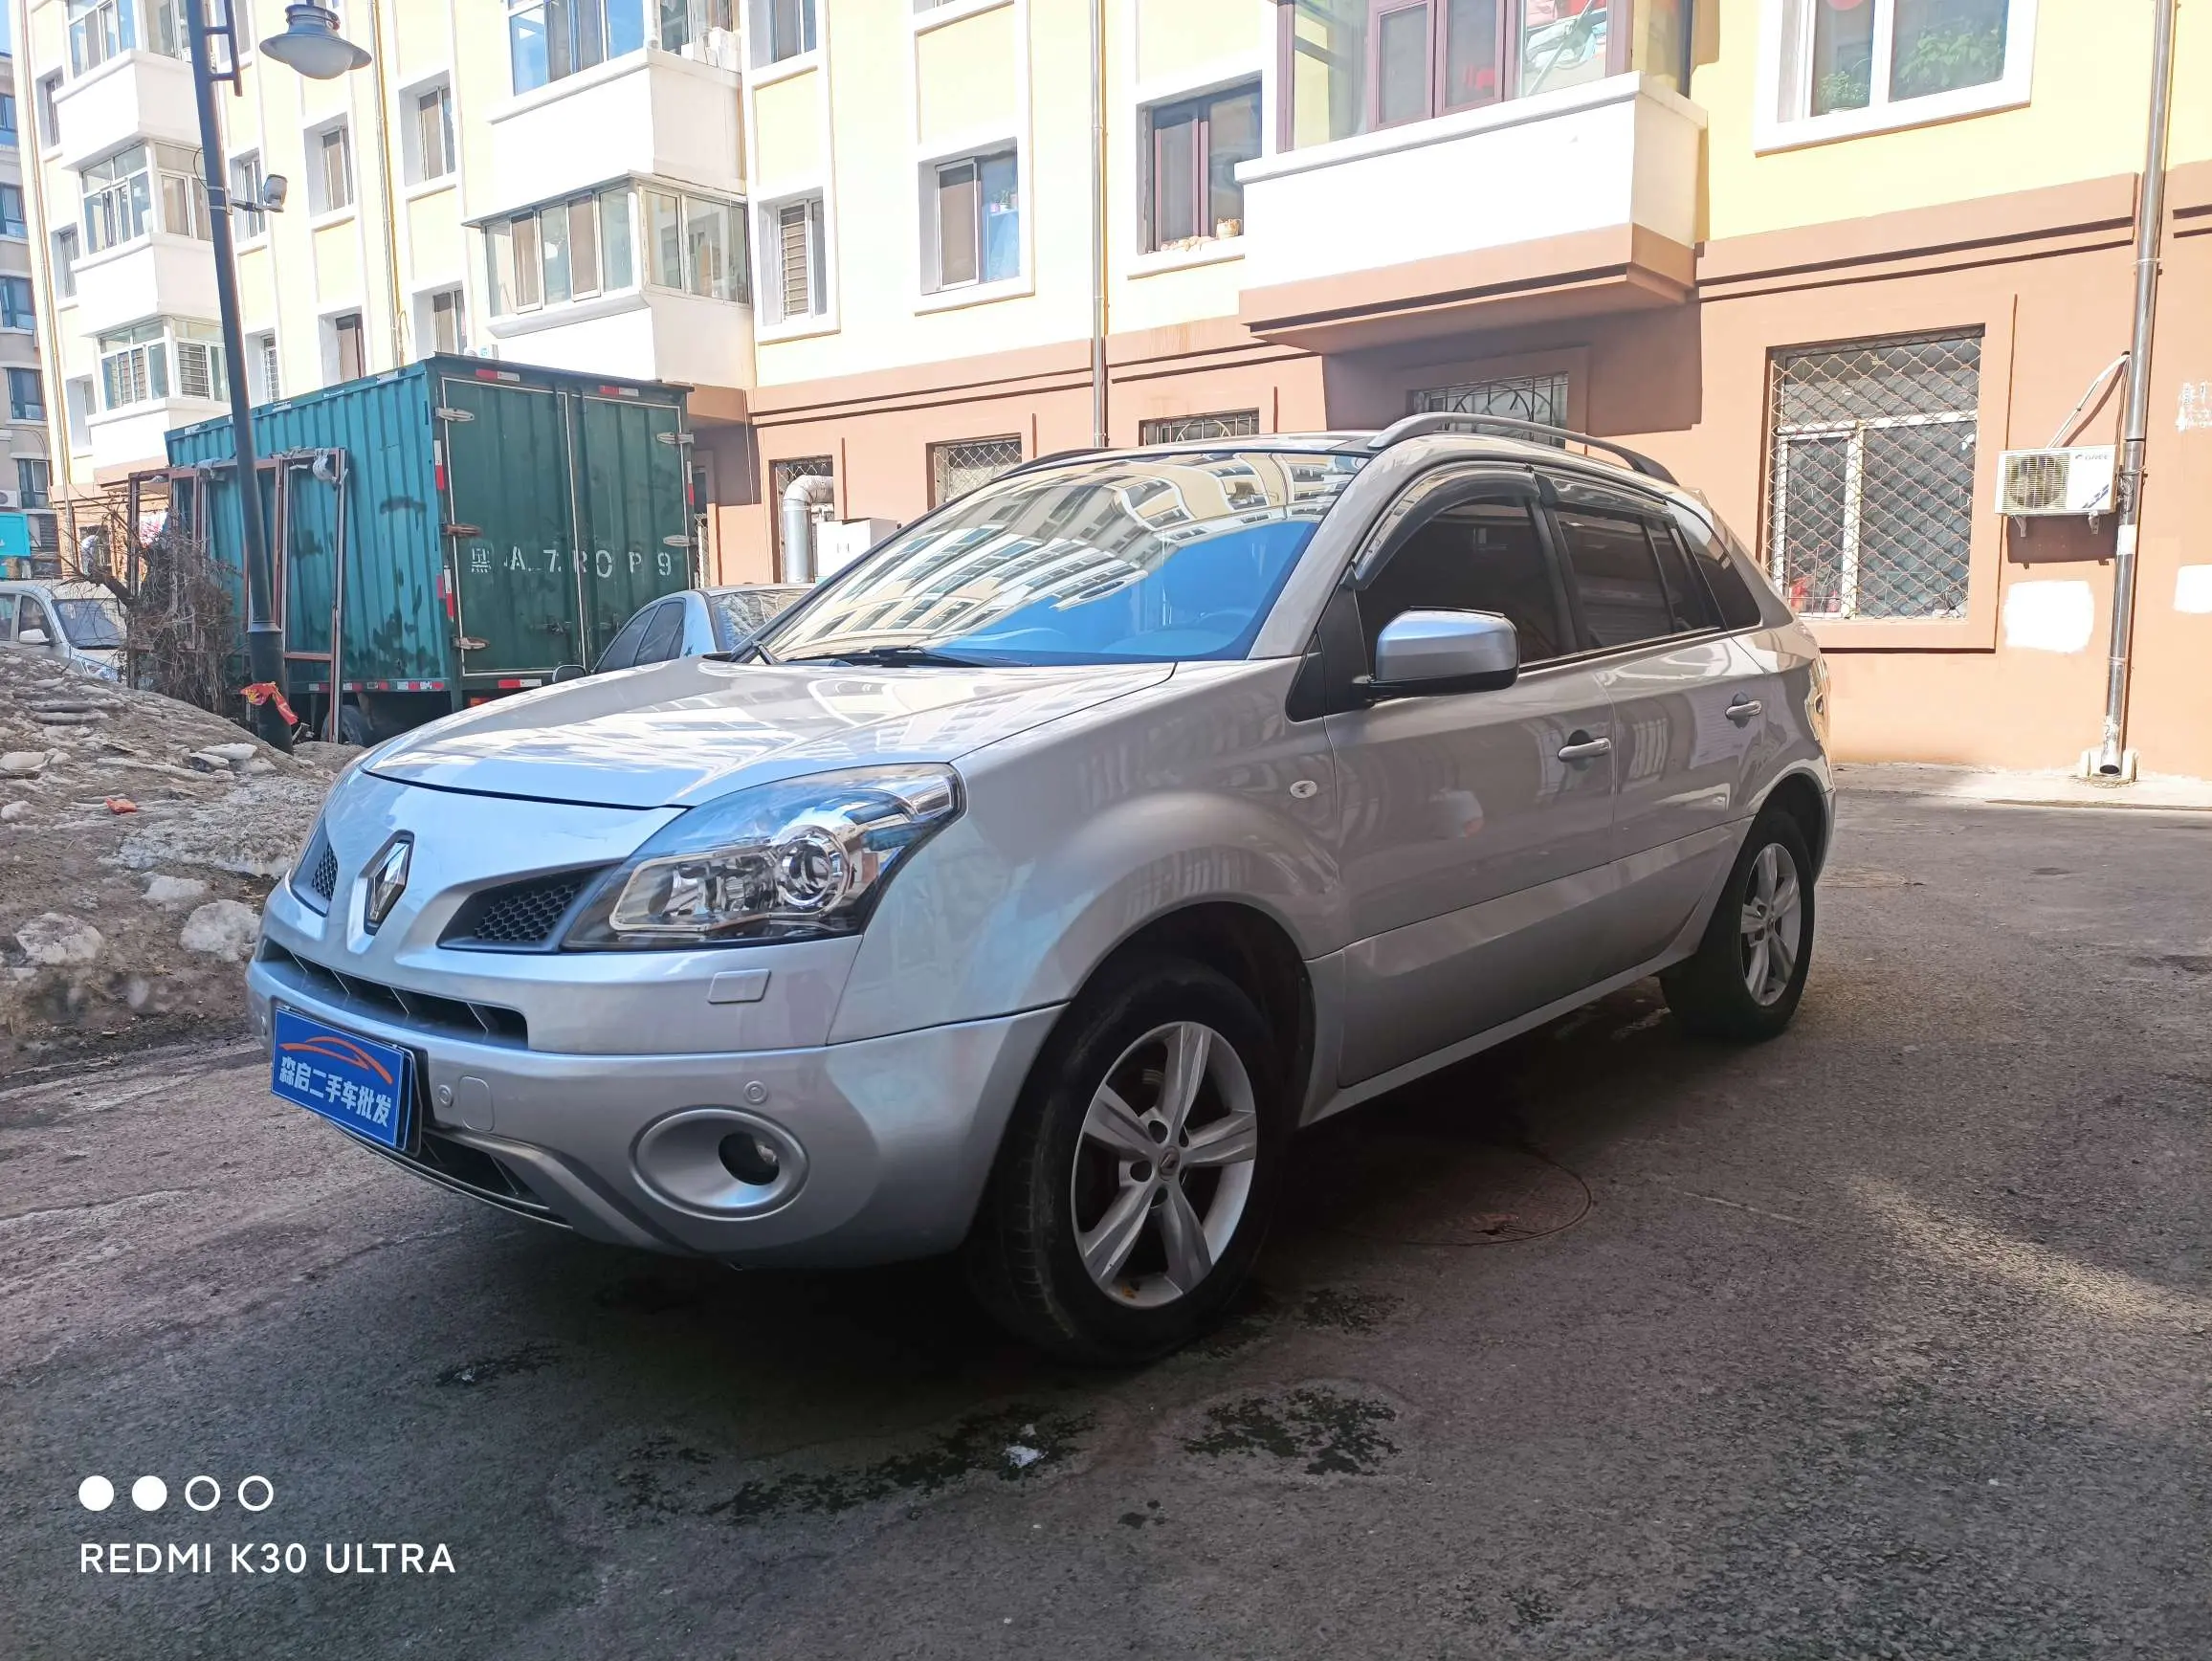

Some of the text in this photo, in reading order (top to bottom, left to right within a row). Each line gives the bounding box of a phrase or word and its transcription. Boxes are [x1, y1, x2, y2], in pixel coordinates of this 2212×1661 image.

[279, 1055, 392, 1127] 森启二手车批发
